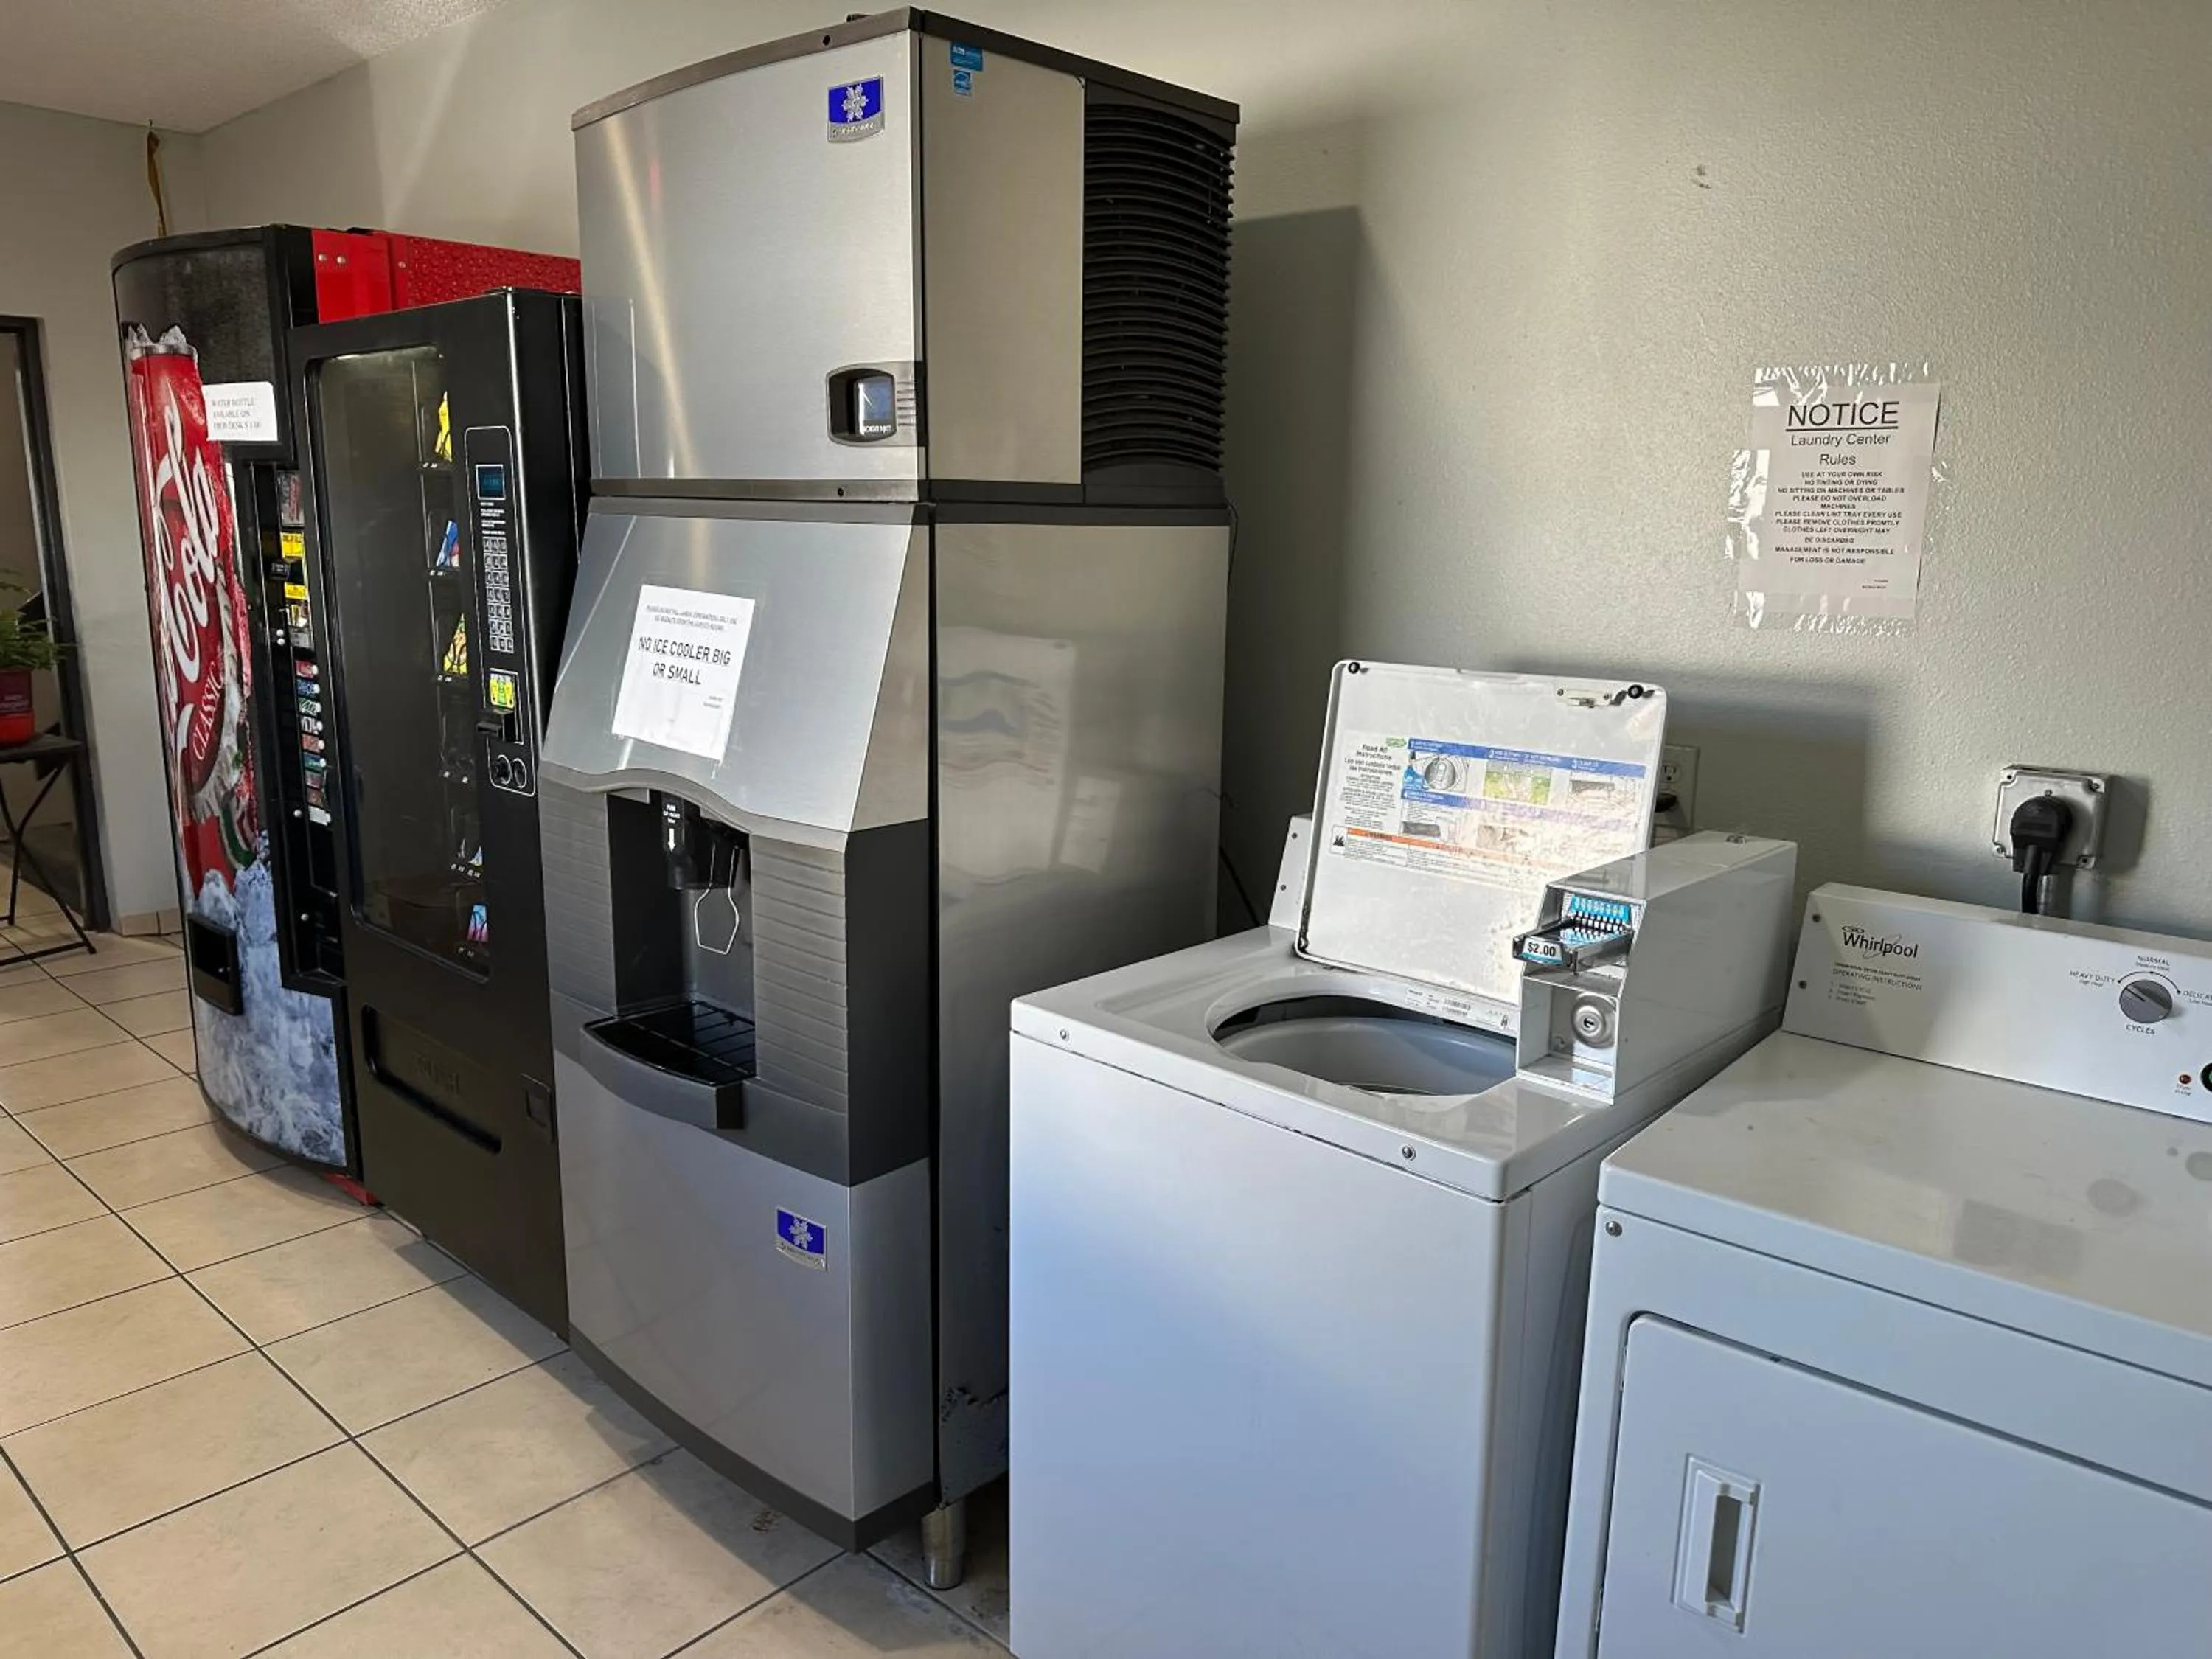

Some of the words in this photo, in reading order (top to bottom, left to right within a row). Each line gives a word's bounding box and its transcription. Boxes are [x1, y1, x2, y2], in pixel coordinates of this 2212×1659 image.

[1787, 401, 1900, 427] NOTICE
[1791, 433, 1843, 447] Laundry
[1846, 432, 1891, 445] Center
[1819, 453, 1857, 465] Rules
[639, 636, 653, 652] NO
[653, 638, 669, 655] ICE
[669, 640, 710, 661] COOLER
[712, 648, 731, 666] BIG
[653, 662, 666, 677] OR
[667, 664, 702, 685] SMALL
[190, 661, 224, 761] CLASSIC
[1526, 942, 1557, 956] $2.00
[1843, 931, 1919, 959] Whirlpool
[1832, 968, 1871, 981] OPERATING
[1871, 975, 1922, 991] INSTRUCTIONS
[2070, 970, 2093, 980] HEAVY
[2095, 975, 2115, 984] DUTY
[2126, 1024, 2156, 1035] CYCLES
